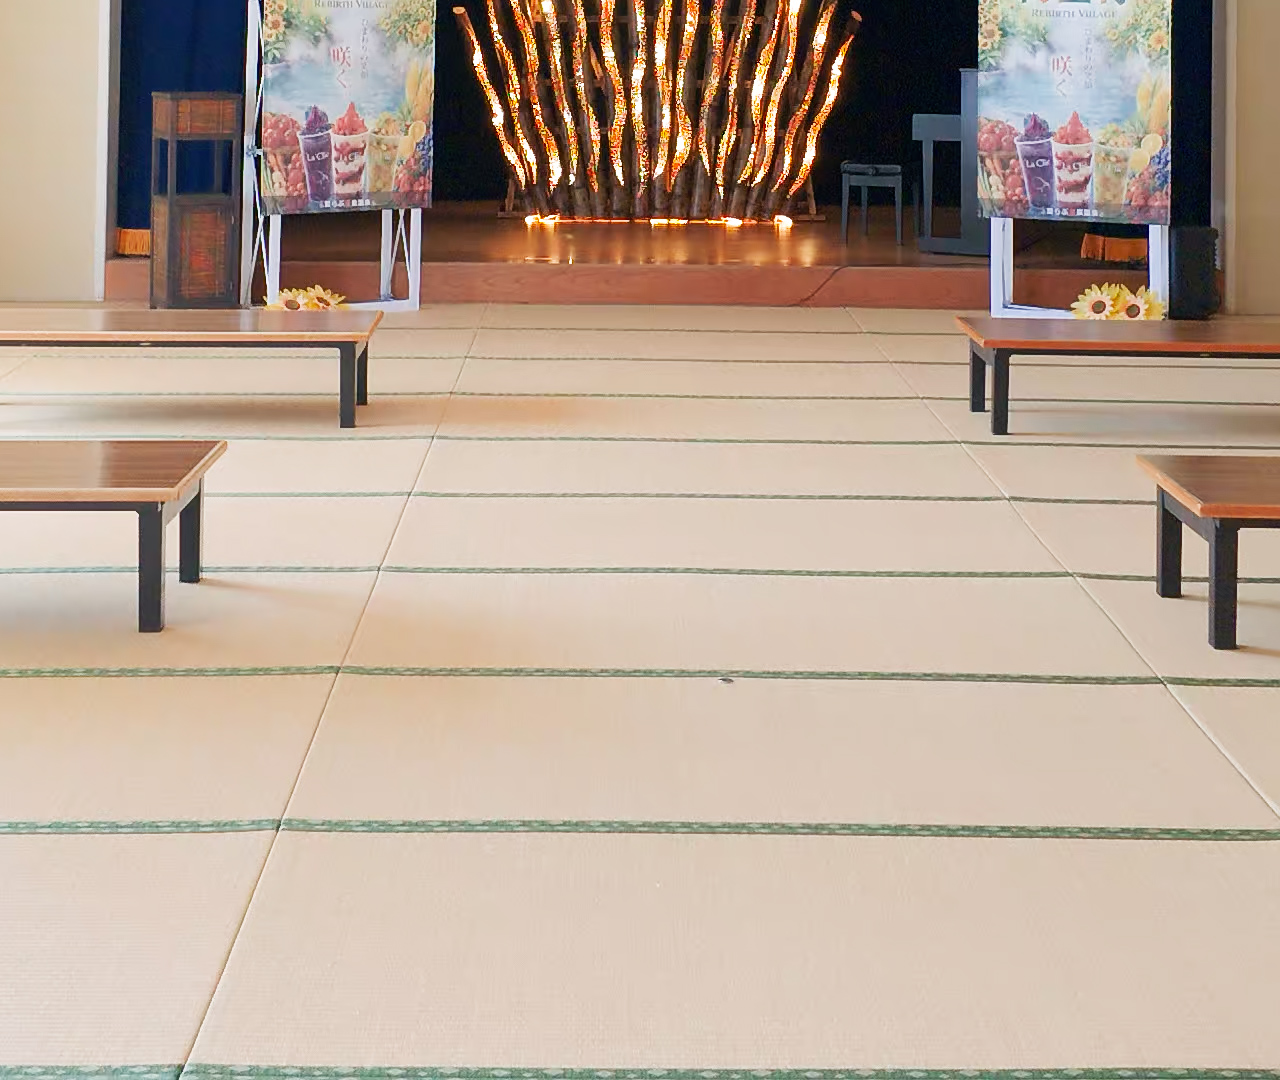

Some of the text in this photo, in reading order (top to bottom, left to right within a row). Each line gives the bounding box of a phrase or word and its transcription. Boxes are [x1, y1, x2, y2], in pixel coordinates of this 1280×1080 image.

[314, 0, 389, 9] REBIRTH VILLAGE
[1031, 9, 1117, 19] REBIRTH VILLAGE
[330, 45, 352, 89] 咲く
[1051, 55, 1073, 98] 咲く
